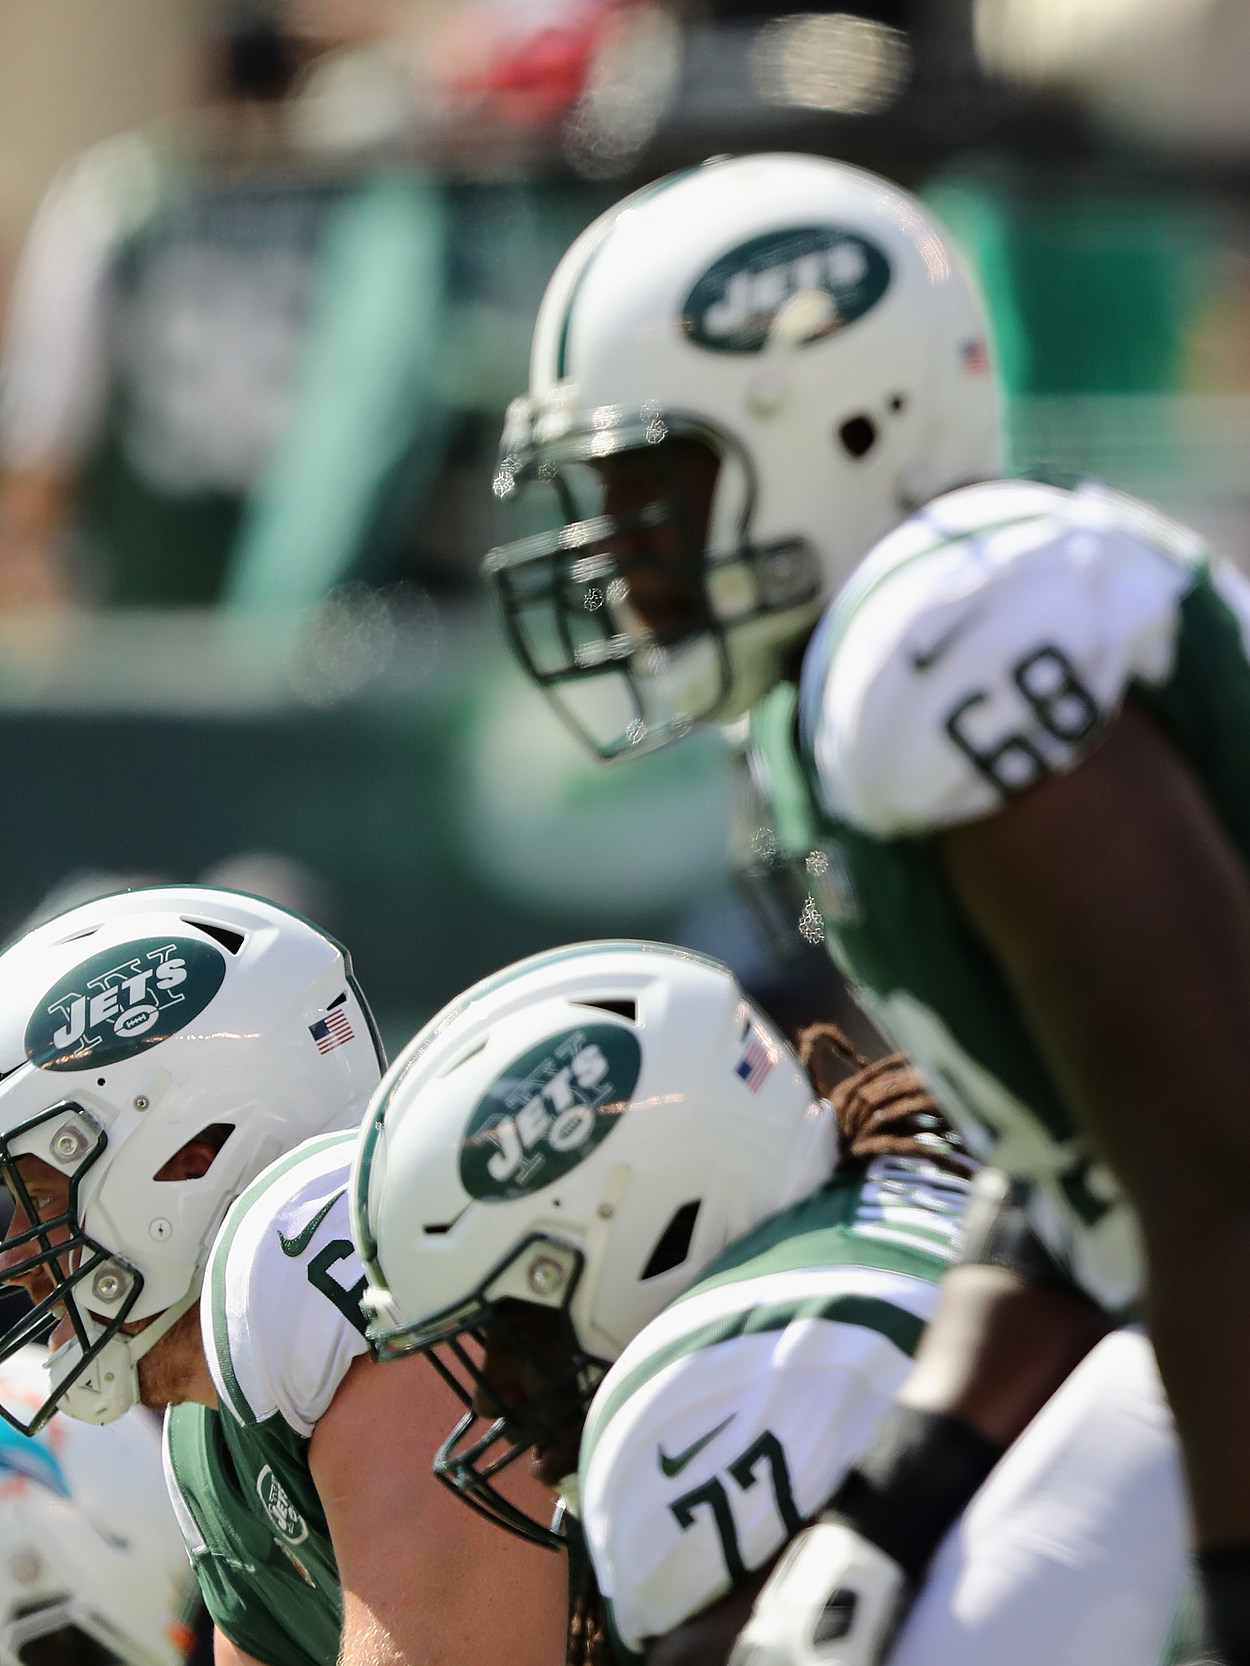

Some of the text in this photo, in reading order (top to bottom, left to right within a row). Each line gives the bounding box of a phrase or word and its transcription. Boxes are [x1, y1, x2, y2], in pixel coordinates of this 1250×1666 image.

[944, 645, 1100, 796] 68
[52, 958, 187, 1049] JETS
[487, 1044, 609, 1182] JETS
[668, 1429, 800, 1587] 77
